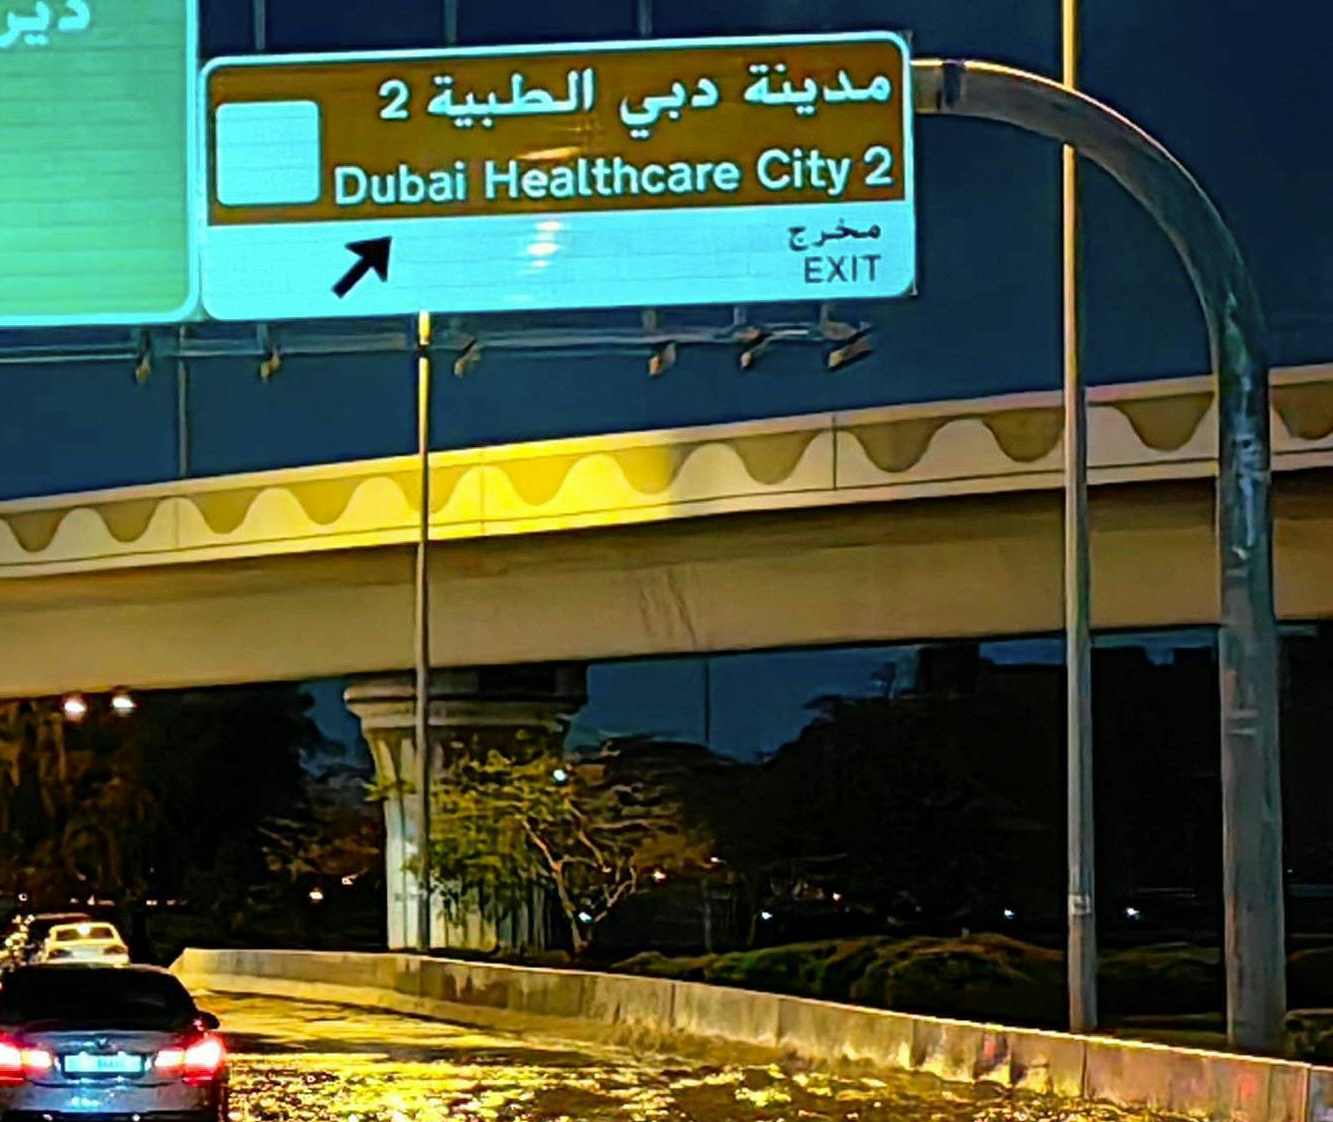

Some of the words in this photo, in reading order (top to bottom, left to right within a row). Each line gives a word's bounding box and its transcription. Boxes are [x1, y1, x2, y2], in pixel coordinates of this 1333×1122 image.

[379, 79, 409, 119] 2
[427, 67, 594, 127] الطبية
[620, 77, 718, 138] دبي
[744, 63, 891, 115] مدينة
[334, 161, 466, 205] Dubai
[485, 156, 741, 200] Healthcare
[757, 148, 851, 197] City
[863, 146, 894, 187] 2
[788, 218, 882, 251] مخرج
[804, 254, 882, 284] EXIT
